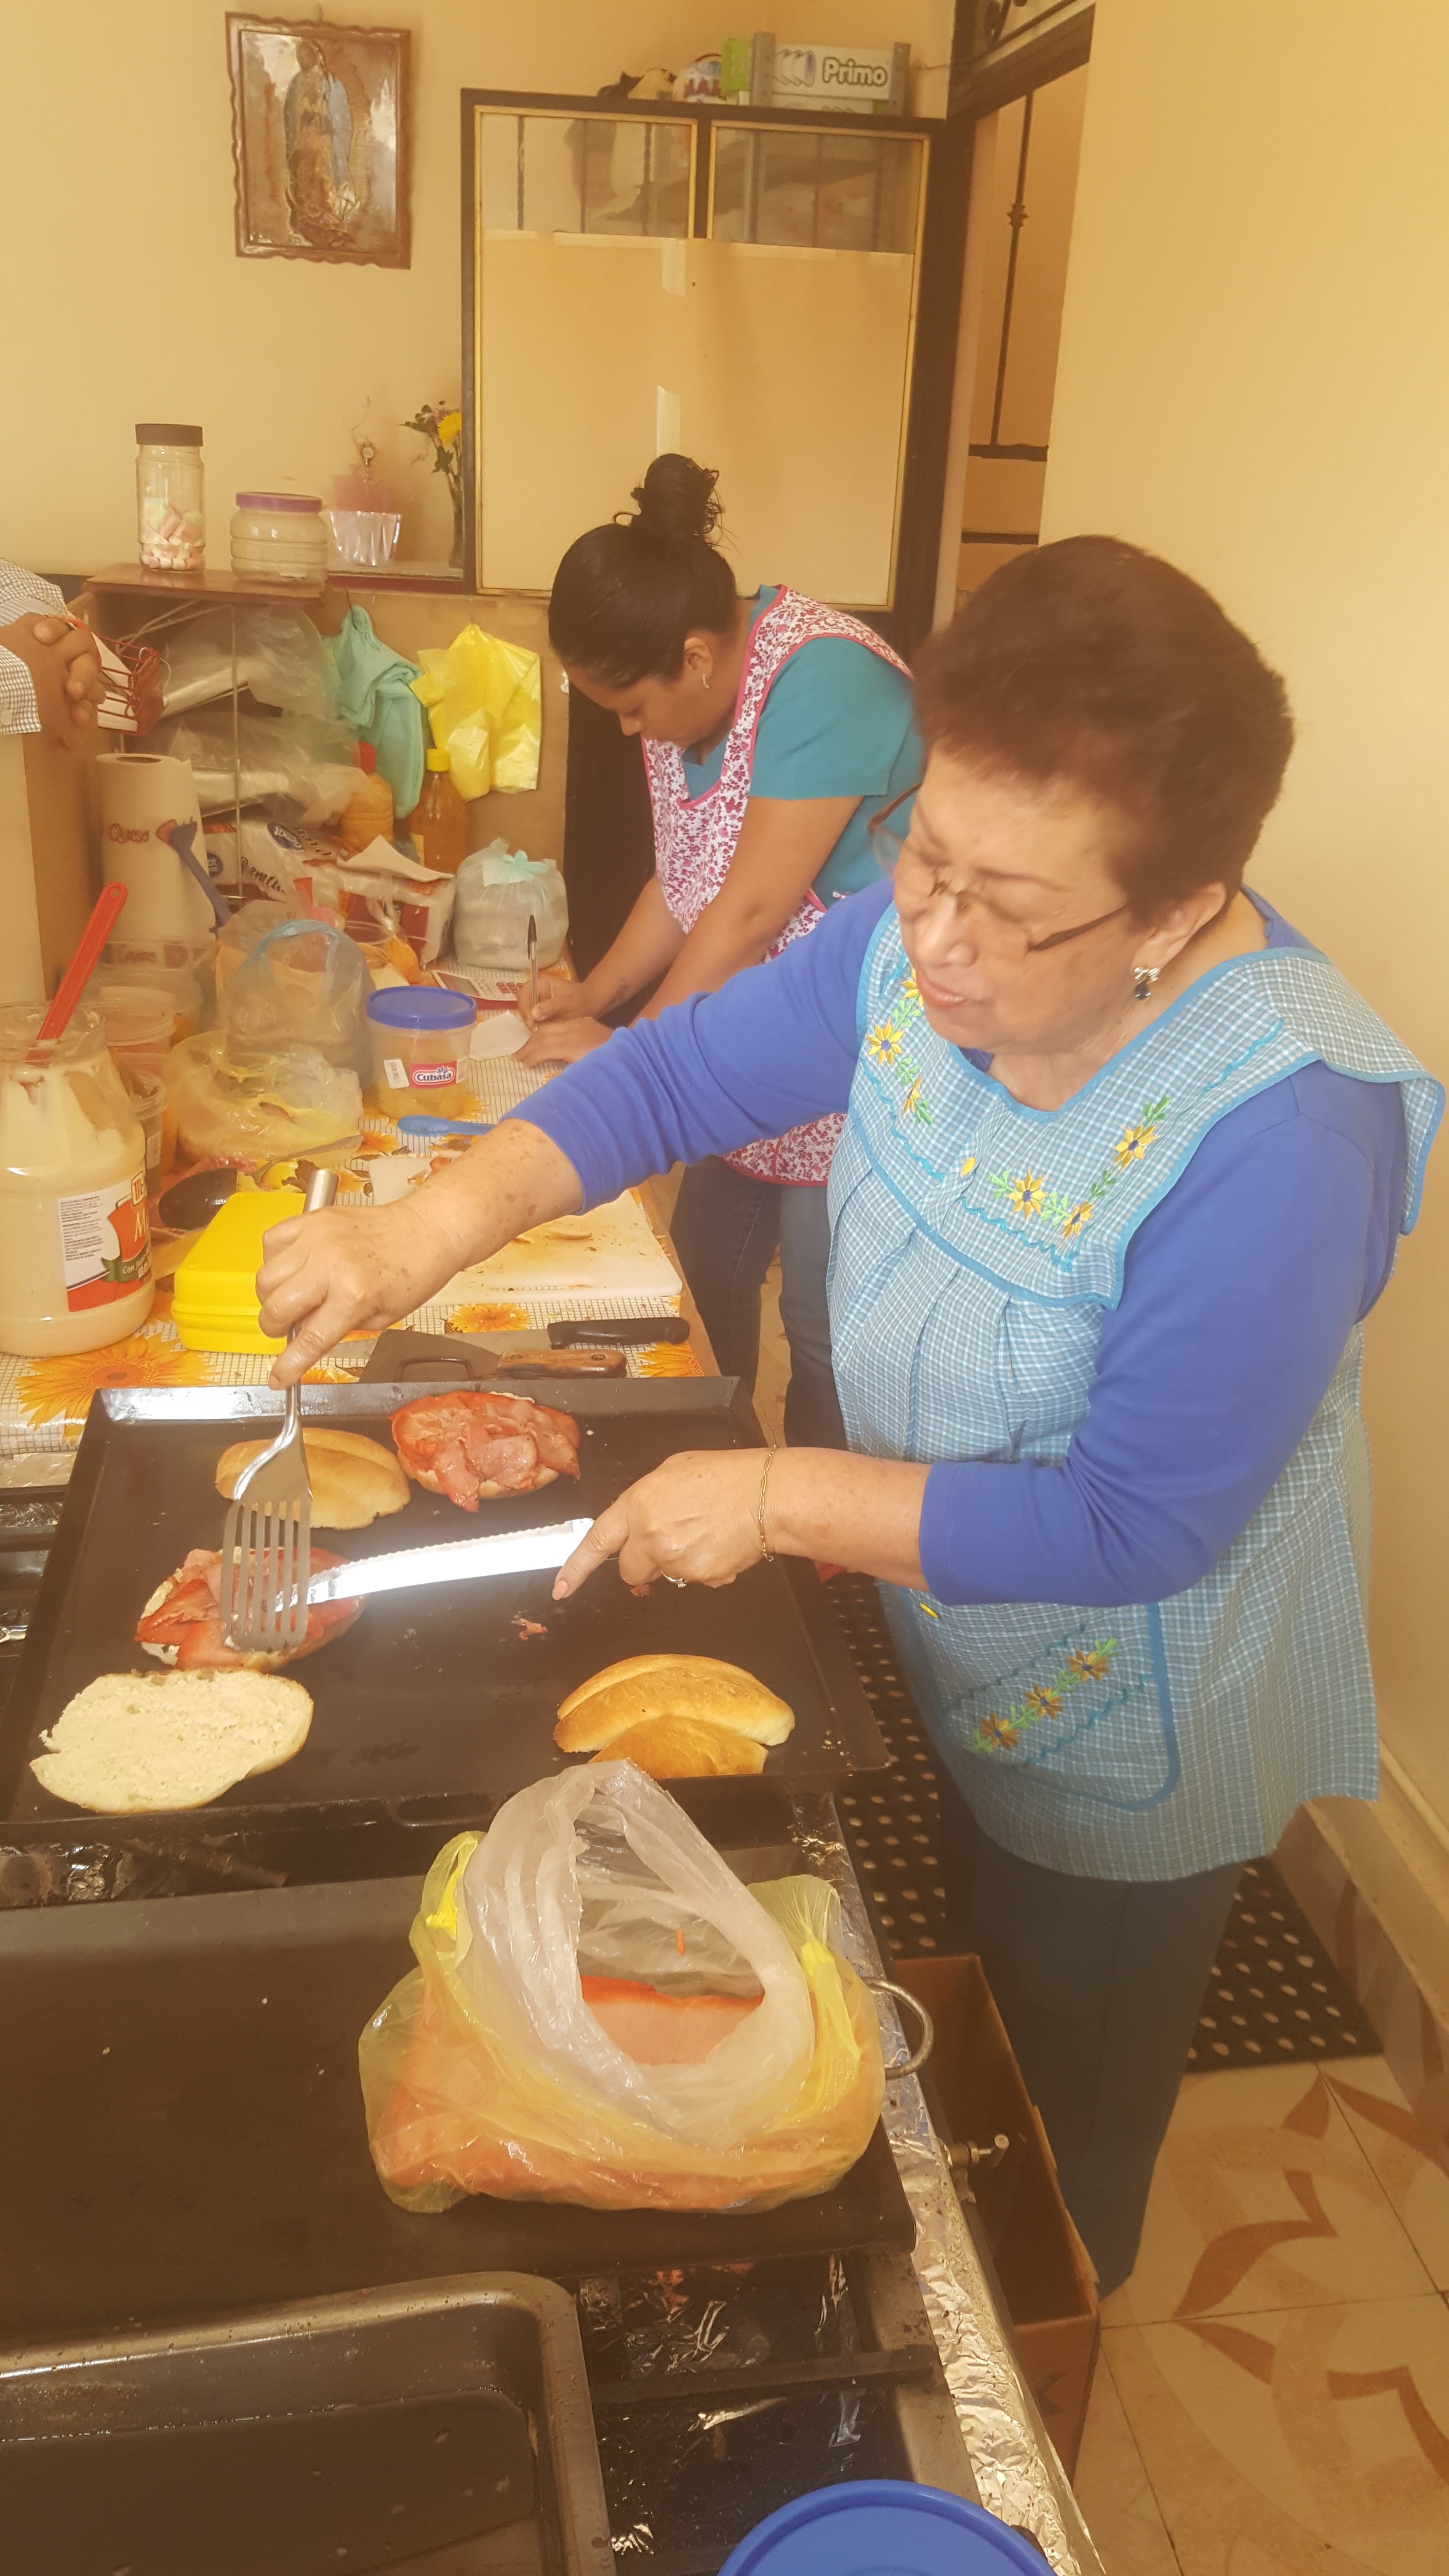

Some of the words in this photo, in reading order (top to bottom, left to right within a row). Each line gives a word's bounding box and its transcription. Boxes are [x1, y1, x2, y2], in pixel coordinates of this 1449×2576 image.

[823, 57, 888, 86] Primo
[416, 1073, 451, 1081] Cubasa
[123, 1265, 135, 1275] Con
